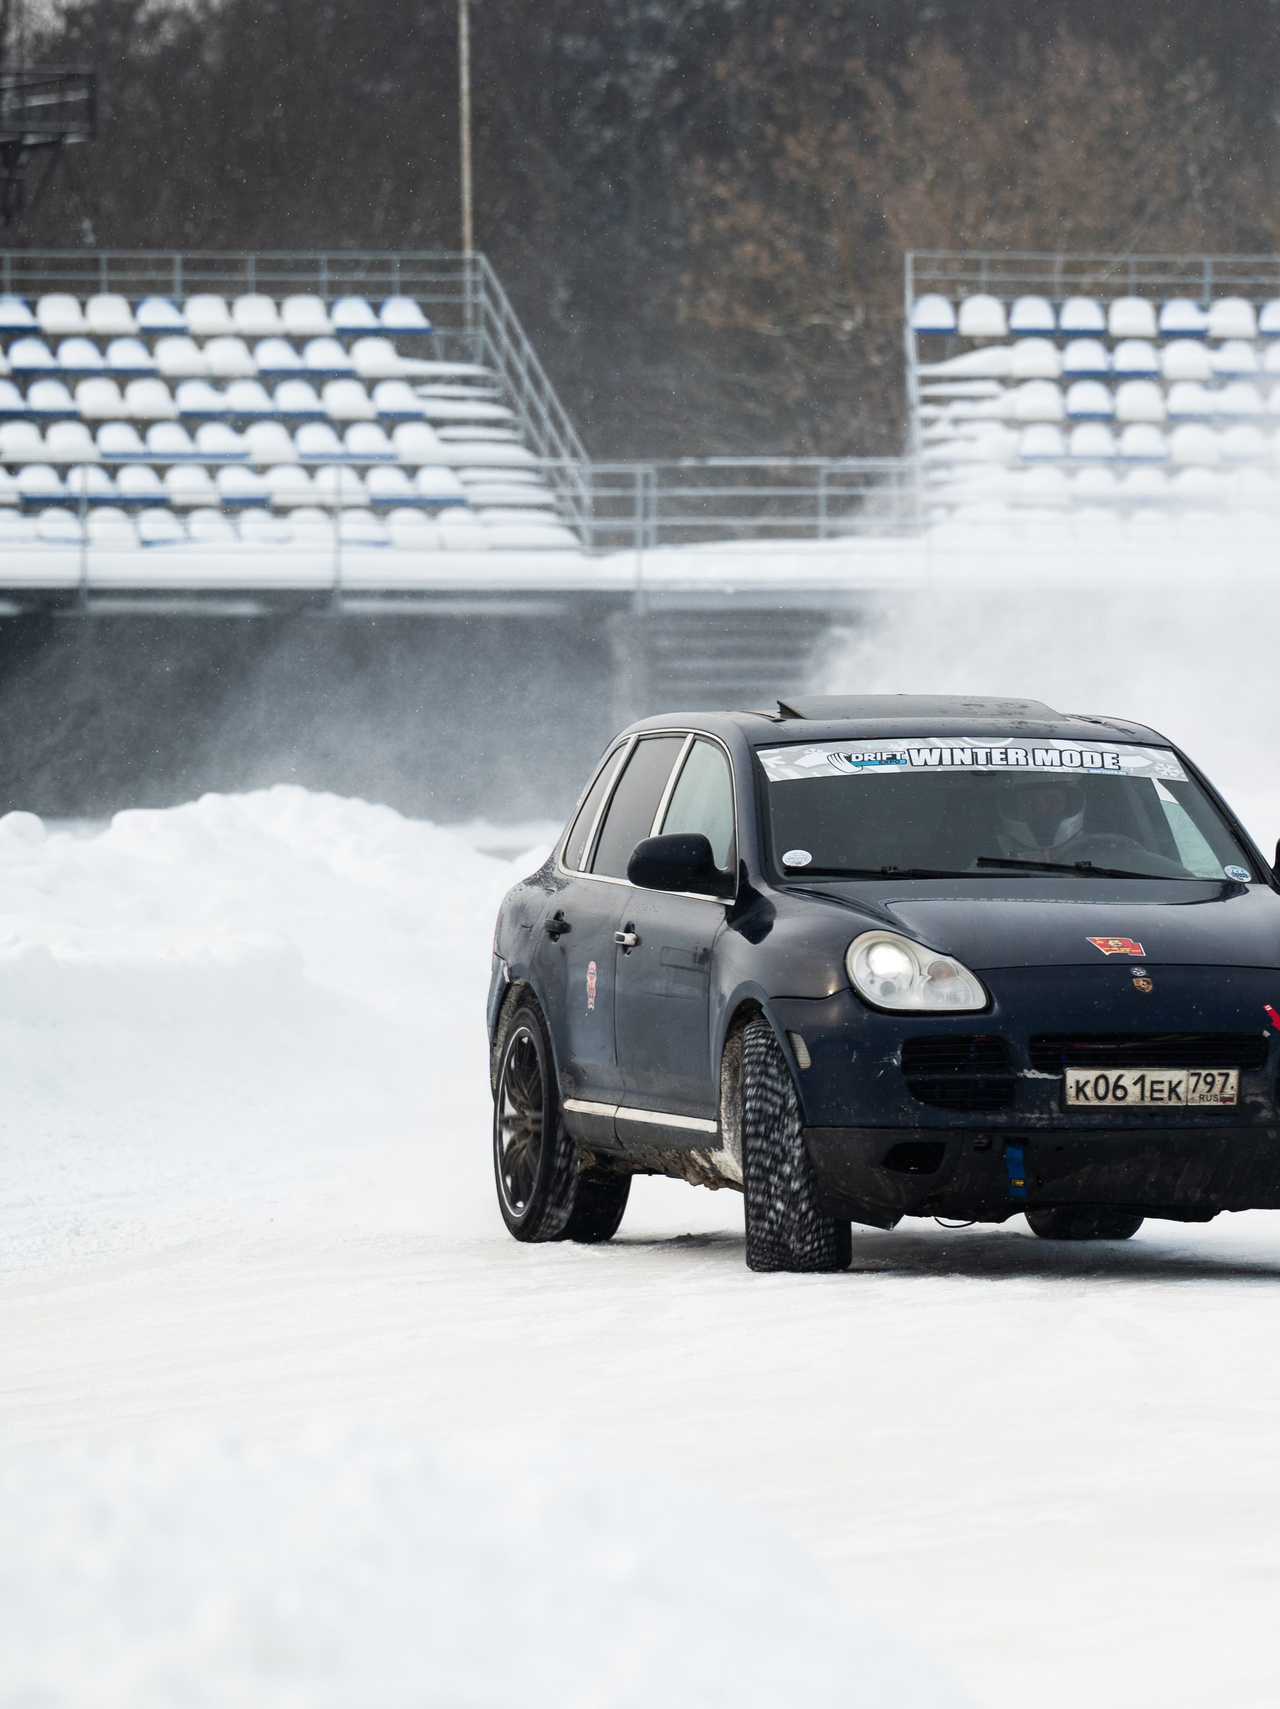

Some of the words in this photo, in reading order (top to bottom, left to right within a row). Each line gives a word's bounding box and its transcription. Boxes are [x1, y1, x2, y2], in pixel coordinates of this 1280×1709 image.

[851, 751, 905, 761] DRIFT
[907, 747, 1028, 766] WINTER
[1032, 748, 1120, 770] MODE
[1190, 1072, 1231, 1094] 797
[1199, 1094, 1219, 1103] RUS
